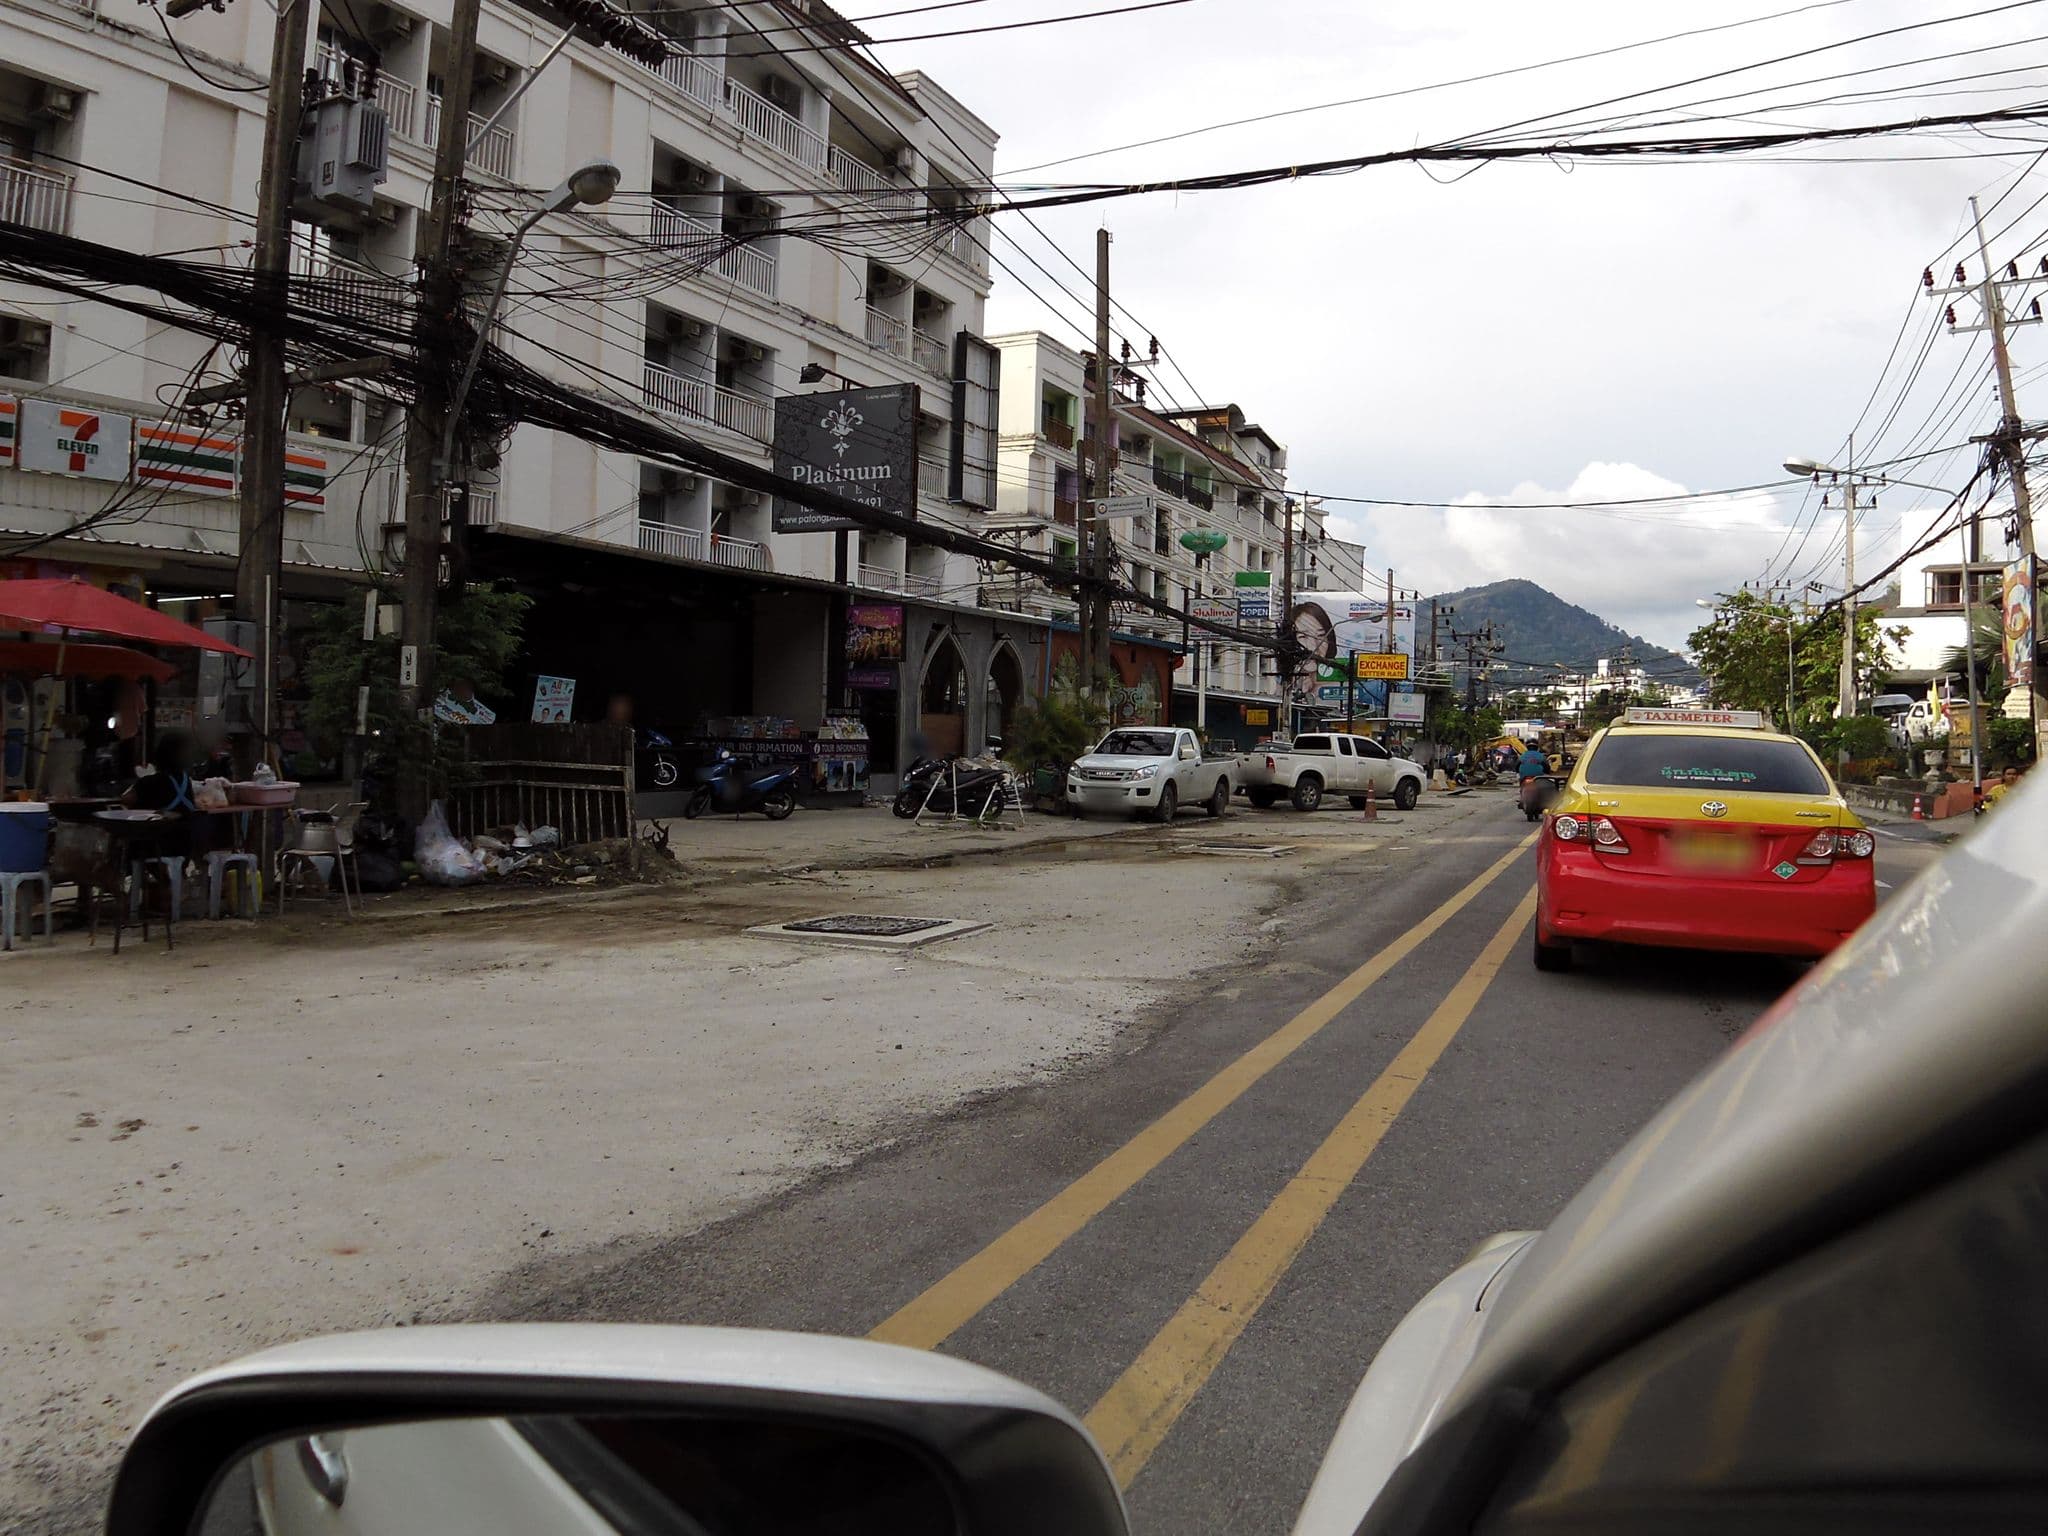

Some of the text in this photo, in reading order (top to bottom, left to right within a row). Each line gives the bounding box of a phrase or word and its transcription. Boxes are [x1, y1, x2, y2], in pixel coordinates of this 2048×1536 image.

[60, 411, 99, 471] 7
[791, 462, 892, 485] Platinum
[1192, 607, 1236, 617] Shalimar
[1359, 660, 1406, 670] EXCHANGE
